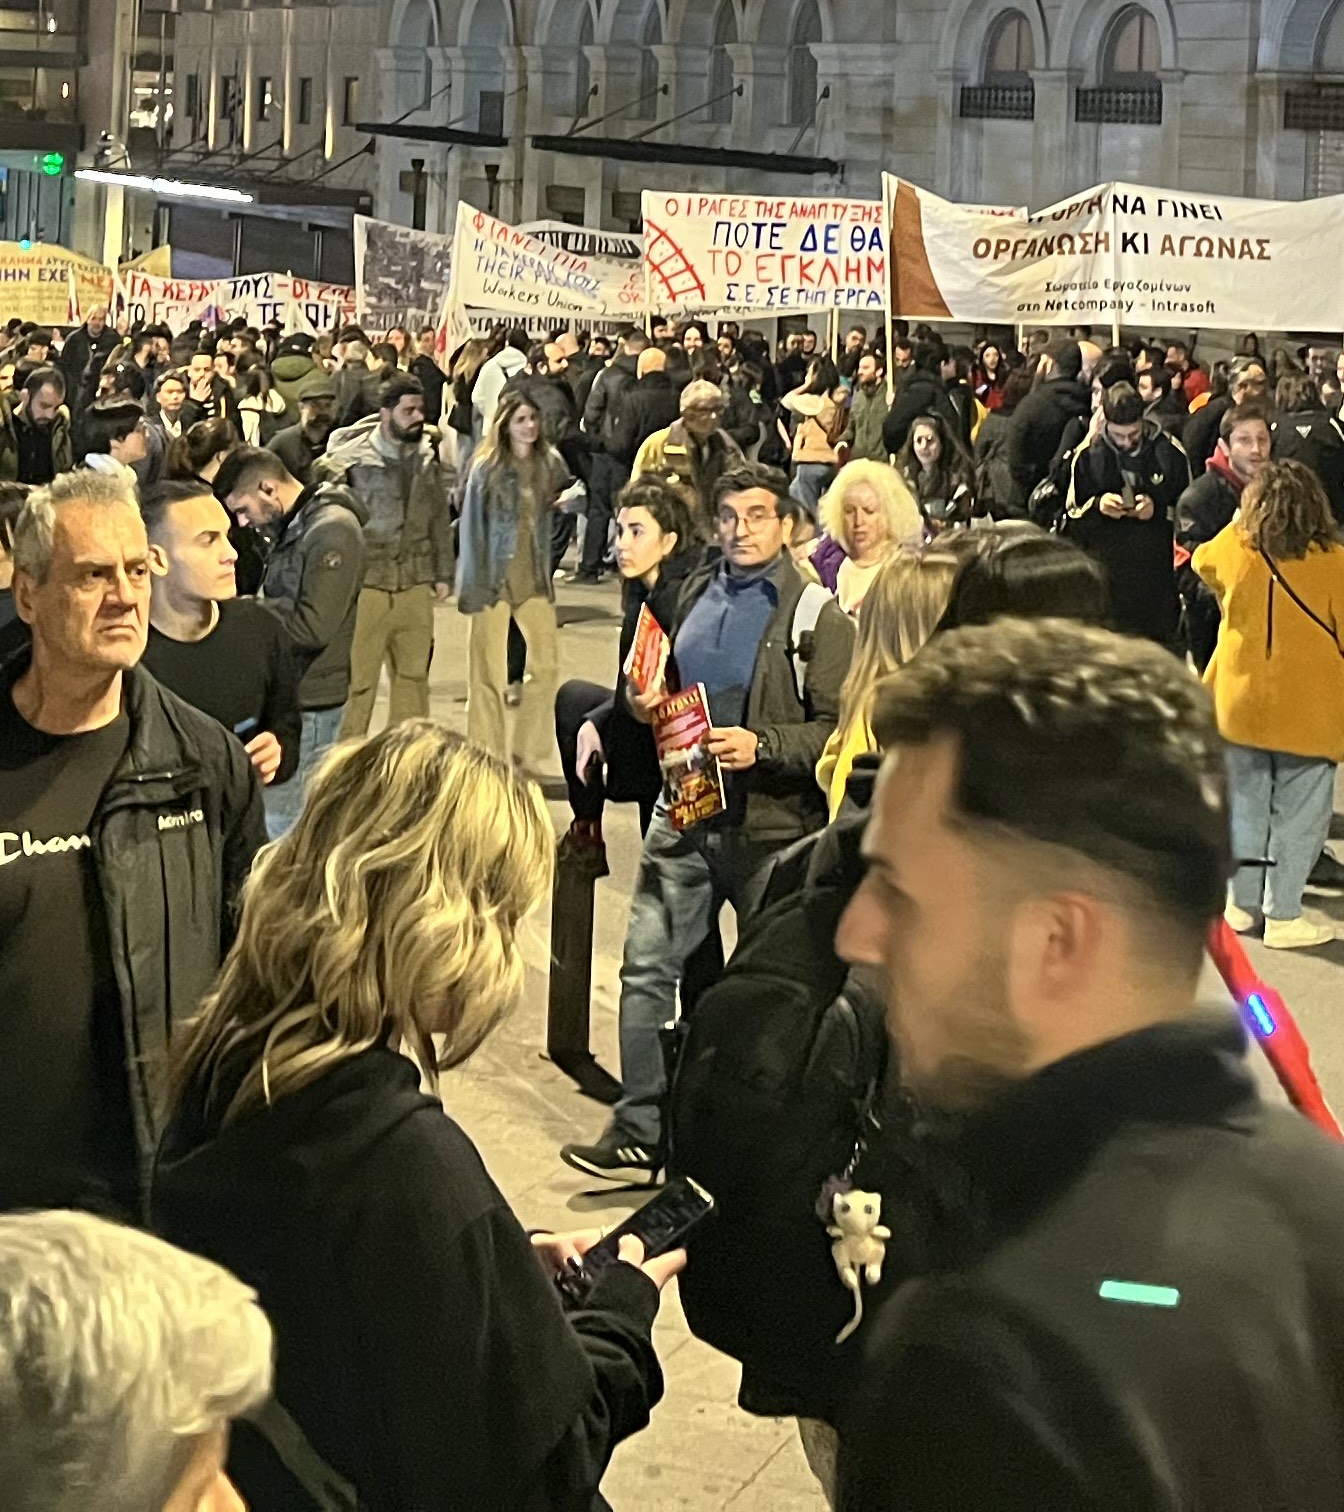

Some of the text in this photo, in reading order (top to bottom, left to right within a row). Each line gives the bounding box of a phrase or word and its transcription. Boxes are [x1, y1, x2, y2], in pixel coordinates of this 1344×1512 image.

[698, 198, 748, 219] ΡΑΓΕΣ
[754, 200, 786, 219] ΤΗΣ
[1113, 194, 1146, 216] ΝΑ
[1158, 198, 1224, 221] ΓΙΝΕΙ
[713, 221, 884, 254] ΠΟΤΕ ΔΕ ΘΑ
[972, 232, 1272, 261] ΟΡΓΑΝΩΣΗ ΚΙ ΑΓΩΝΑΣ
[708, 250, 885, 286] ΤΟ ΕΓΚΛΗΜ
[834, 289, 885, 307] ΕΡΓΑ
[1045, 299, 1134, 313] Netcompany
[1152, 299, 1216, 314] Intrasoft
